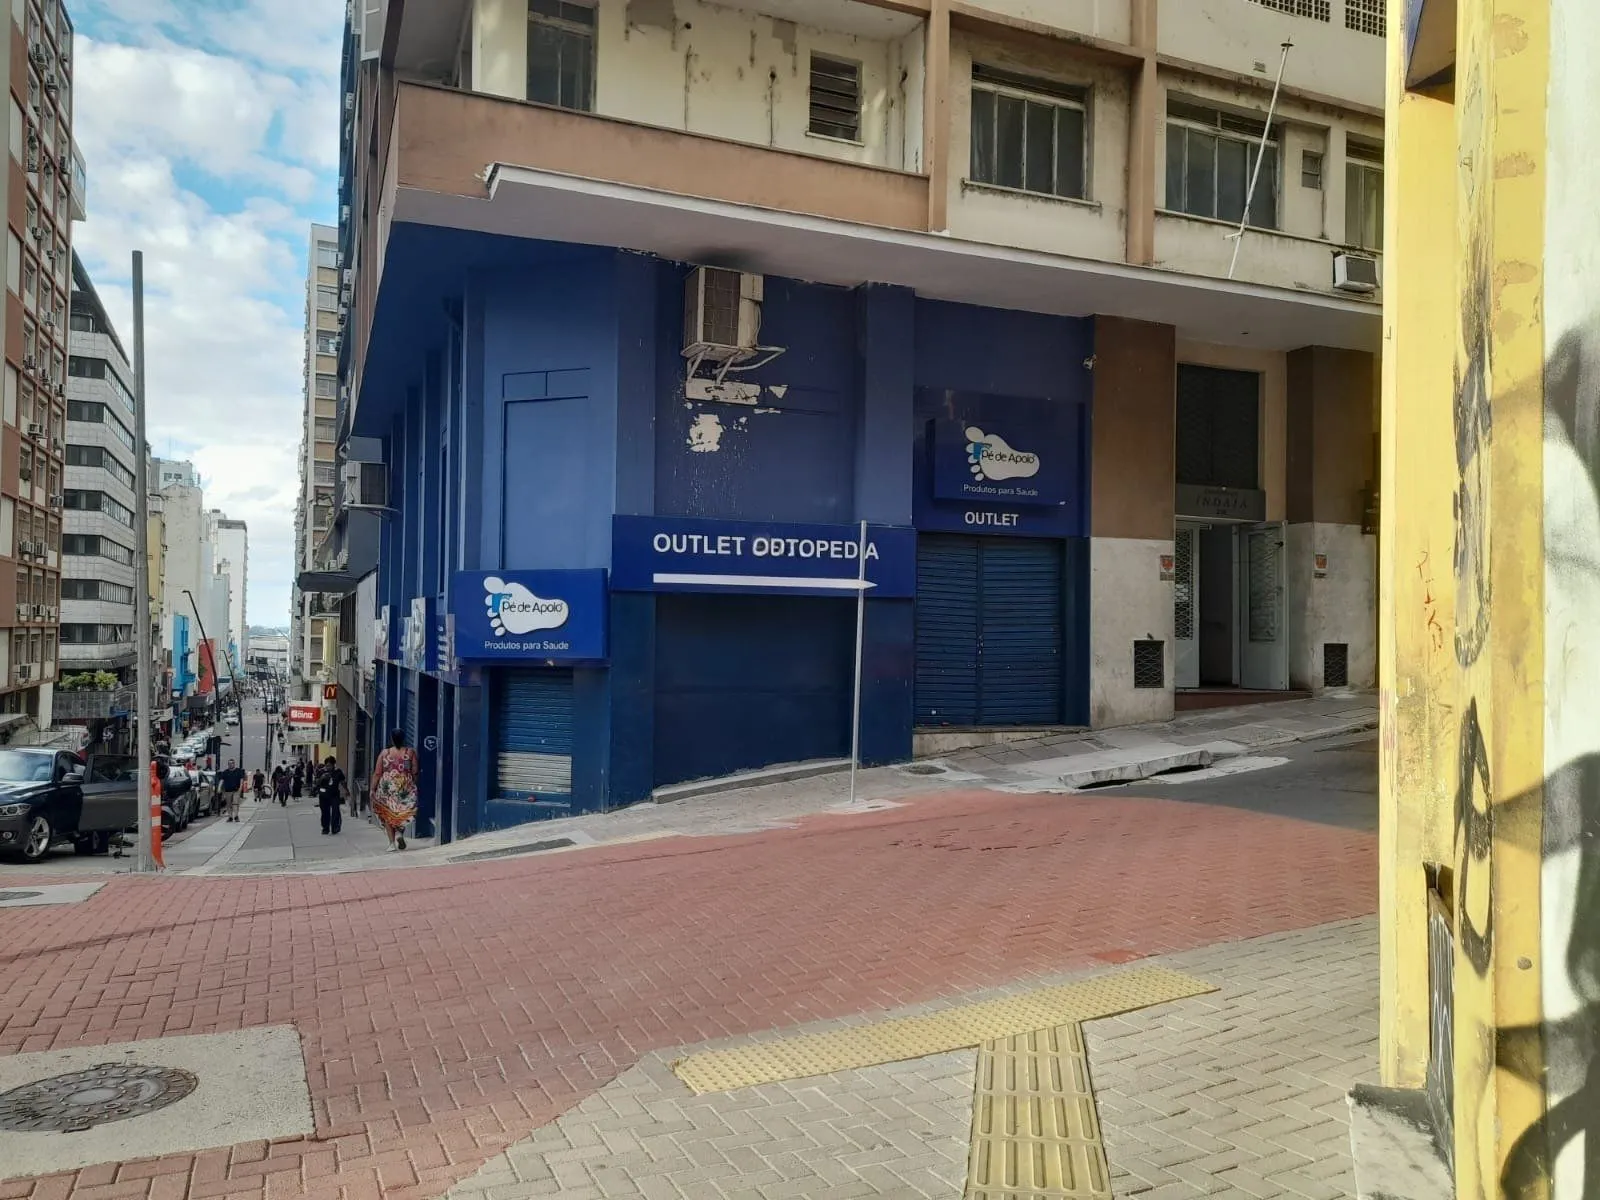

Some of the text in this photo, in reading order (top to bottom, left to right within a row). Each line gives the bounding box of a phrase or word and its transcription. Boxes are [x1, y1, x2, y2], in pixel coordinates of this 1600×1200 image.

[982, 450, 1034, 464] Pé de Apoio
[963, 484, 997, 494] Produtos
[998, 487, 1015, 496] para
[964, 511, 1019, 526] OUTLET
[653, 534, 745, 556] OUTLET
[502, 601, 563, 614] Pé de Apoio
[485, 640, 521, 649] Produtos
[522, 642, 541, 651] para
